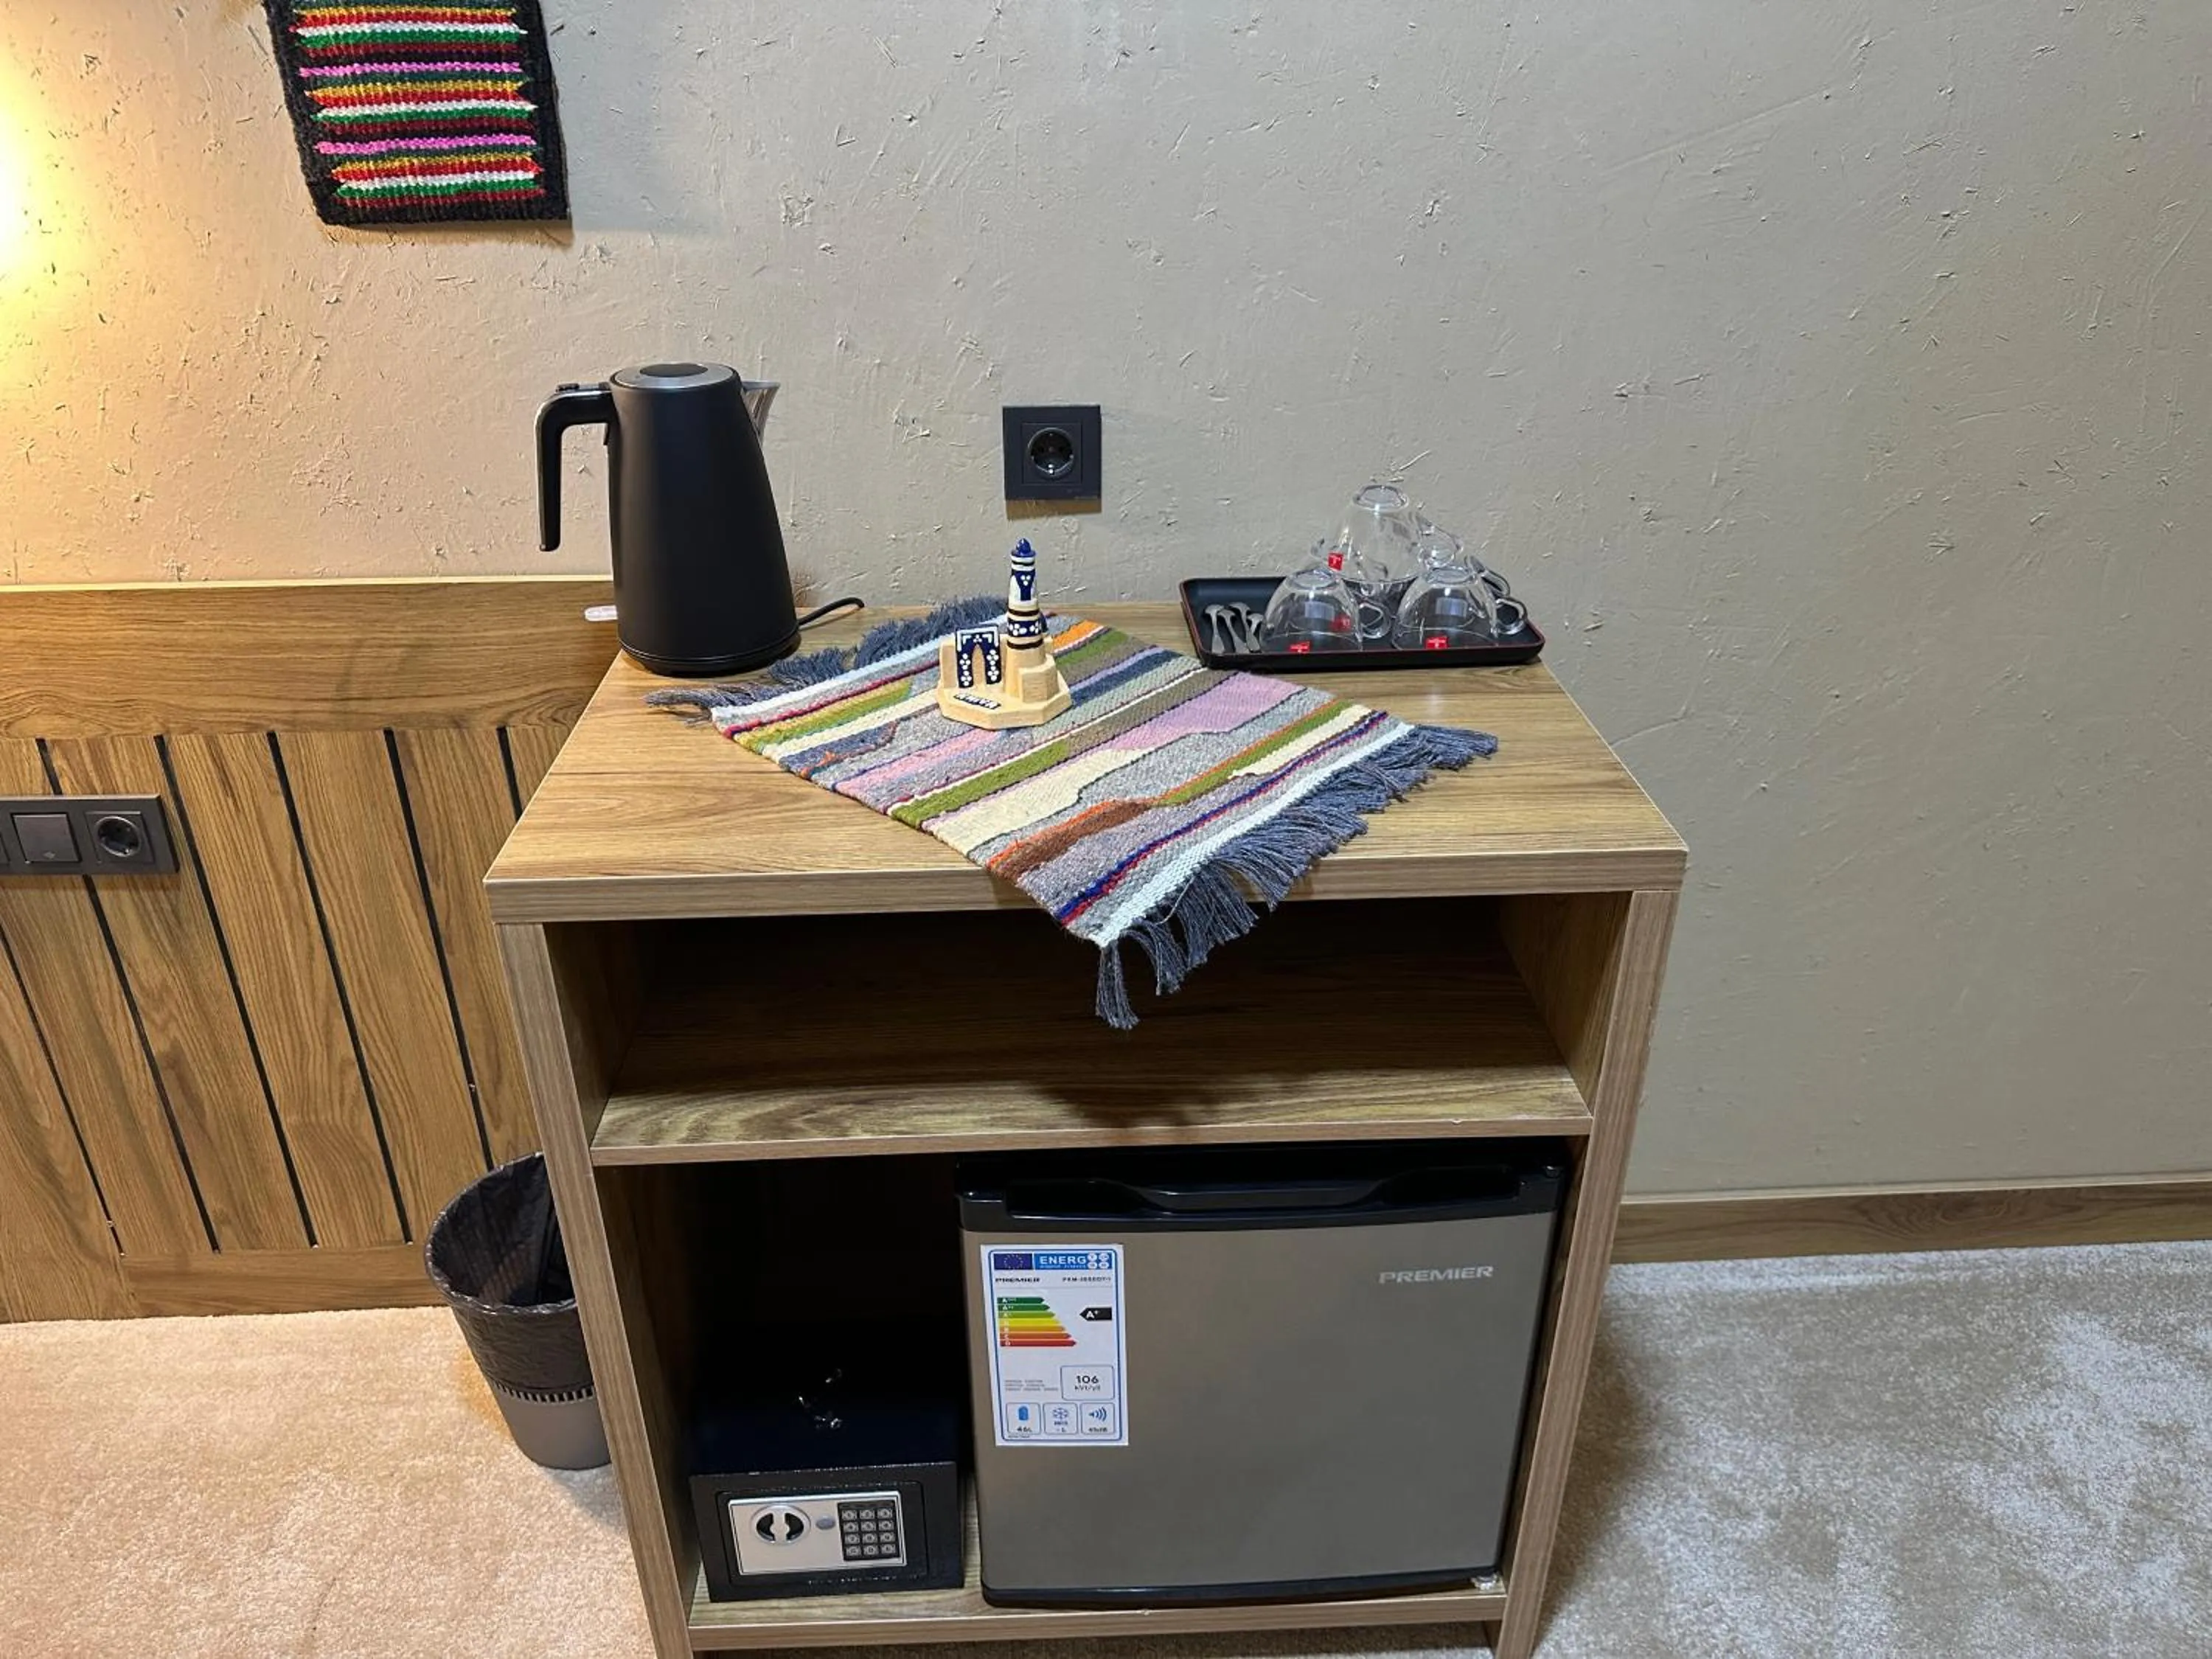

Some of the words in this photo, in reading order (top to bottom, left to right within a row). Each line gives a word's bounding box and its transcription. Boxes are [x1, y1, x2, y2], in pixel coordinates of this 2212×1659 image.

[1040, 1256, 1086, 1265] ENERG
[1378, 1265, 1494, 1284] PREMIER
[1076, 1375, 1099, 1384] 106
